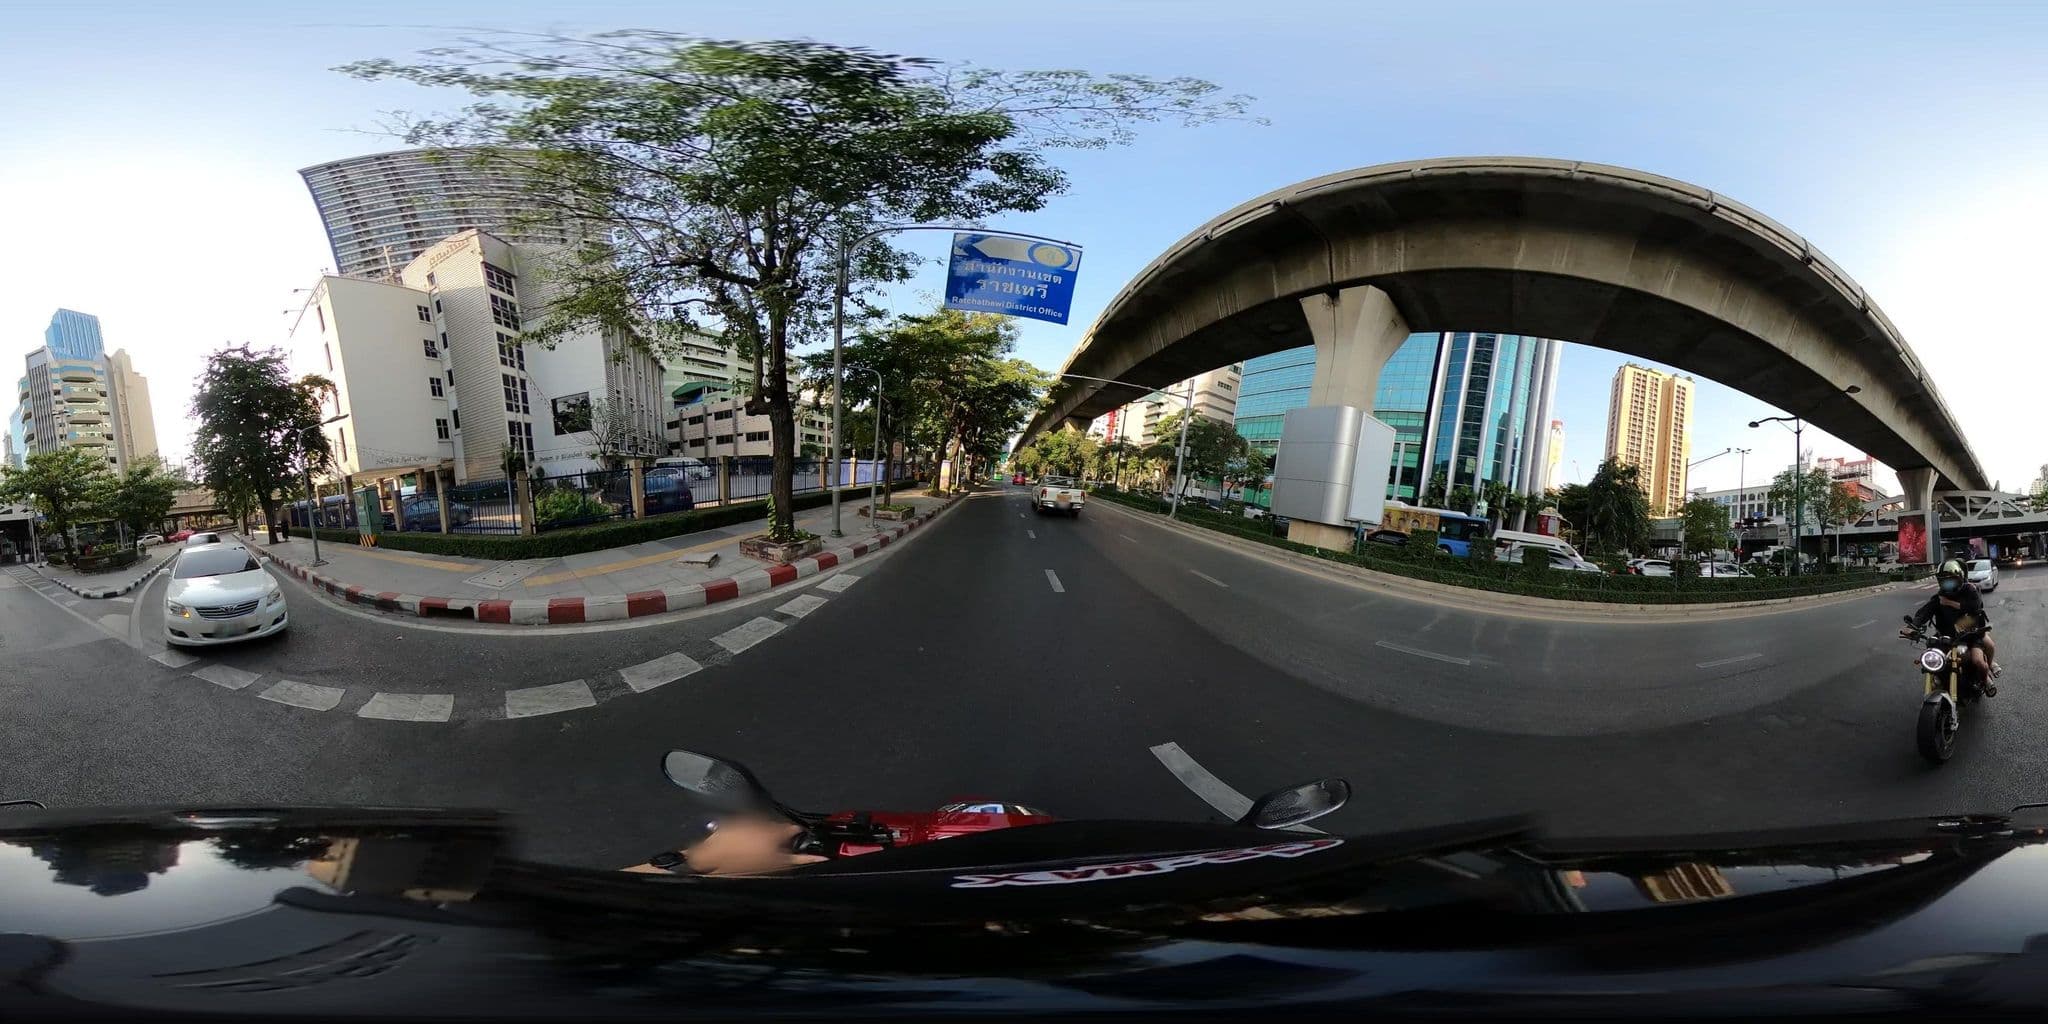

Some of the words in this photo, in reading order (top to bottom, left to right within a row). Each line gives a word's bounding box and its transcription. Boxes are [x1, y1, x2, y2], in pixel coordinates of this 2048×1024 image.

[976, 279, 1048, 299] ราชเทวี
[1006, 301, 1037, 313] District
[1038, 306, 1063, 318] Office
